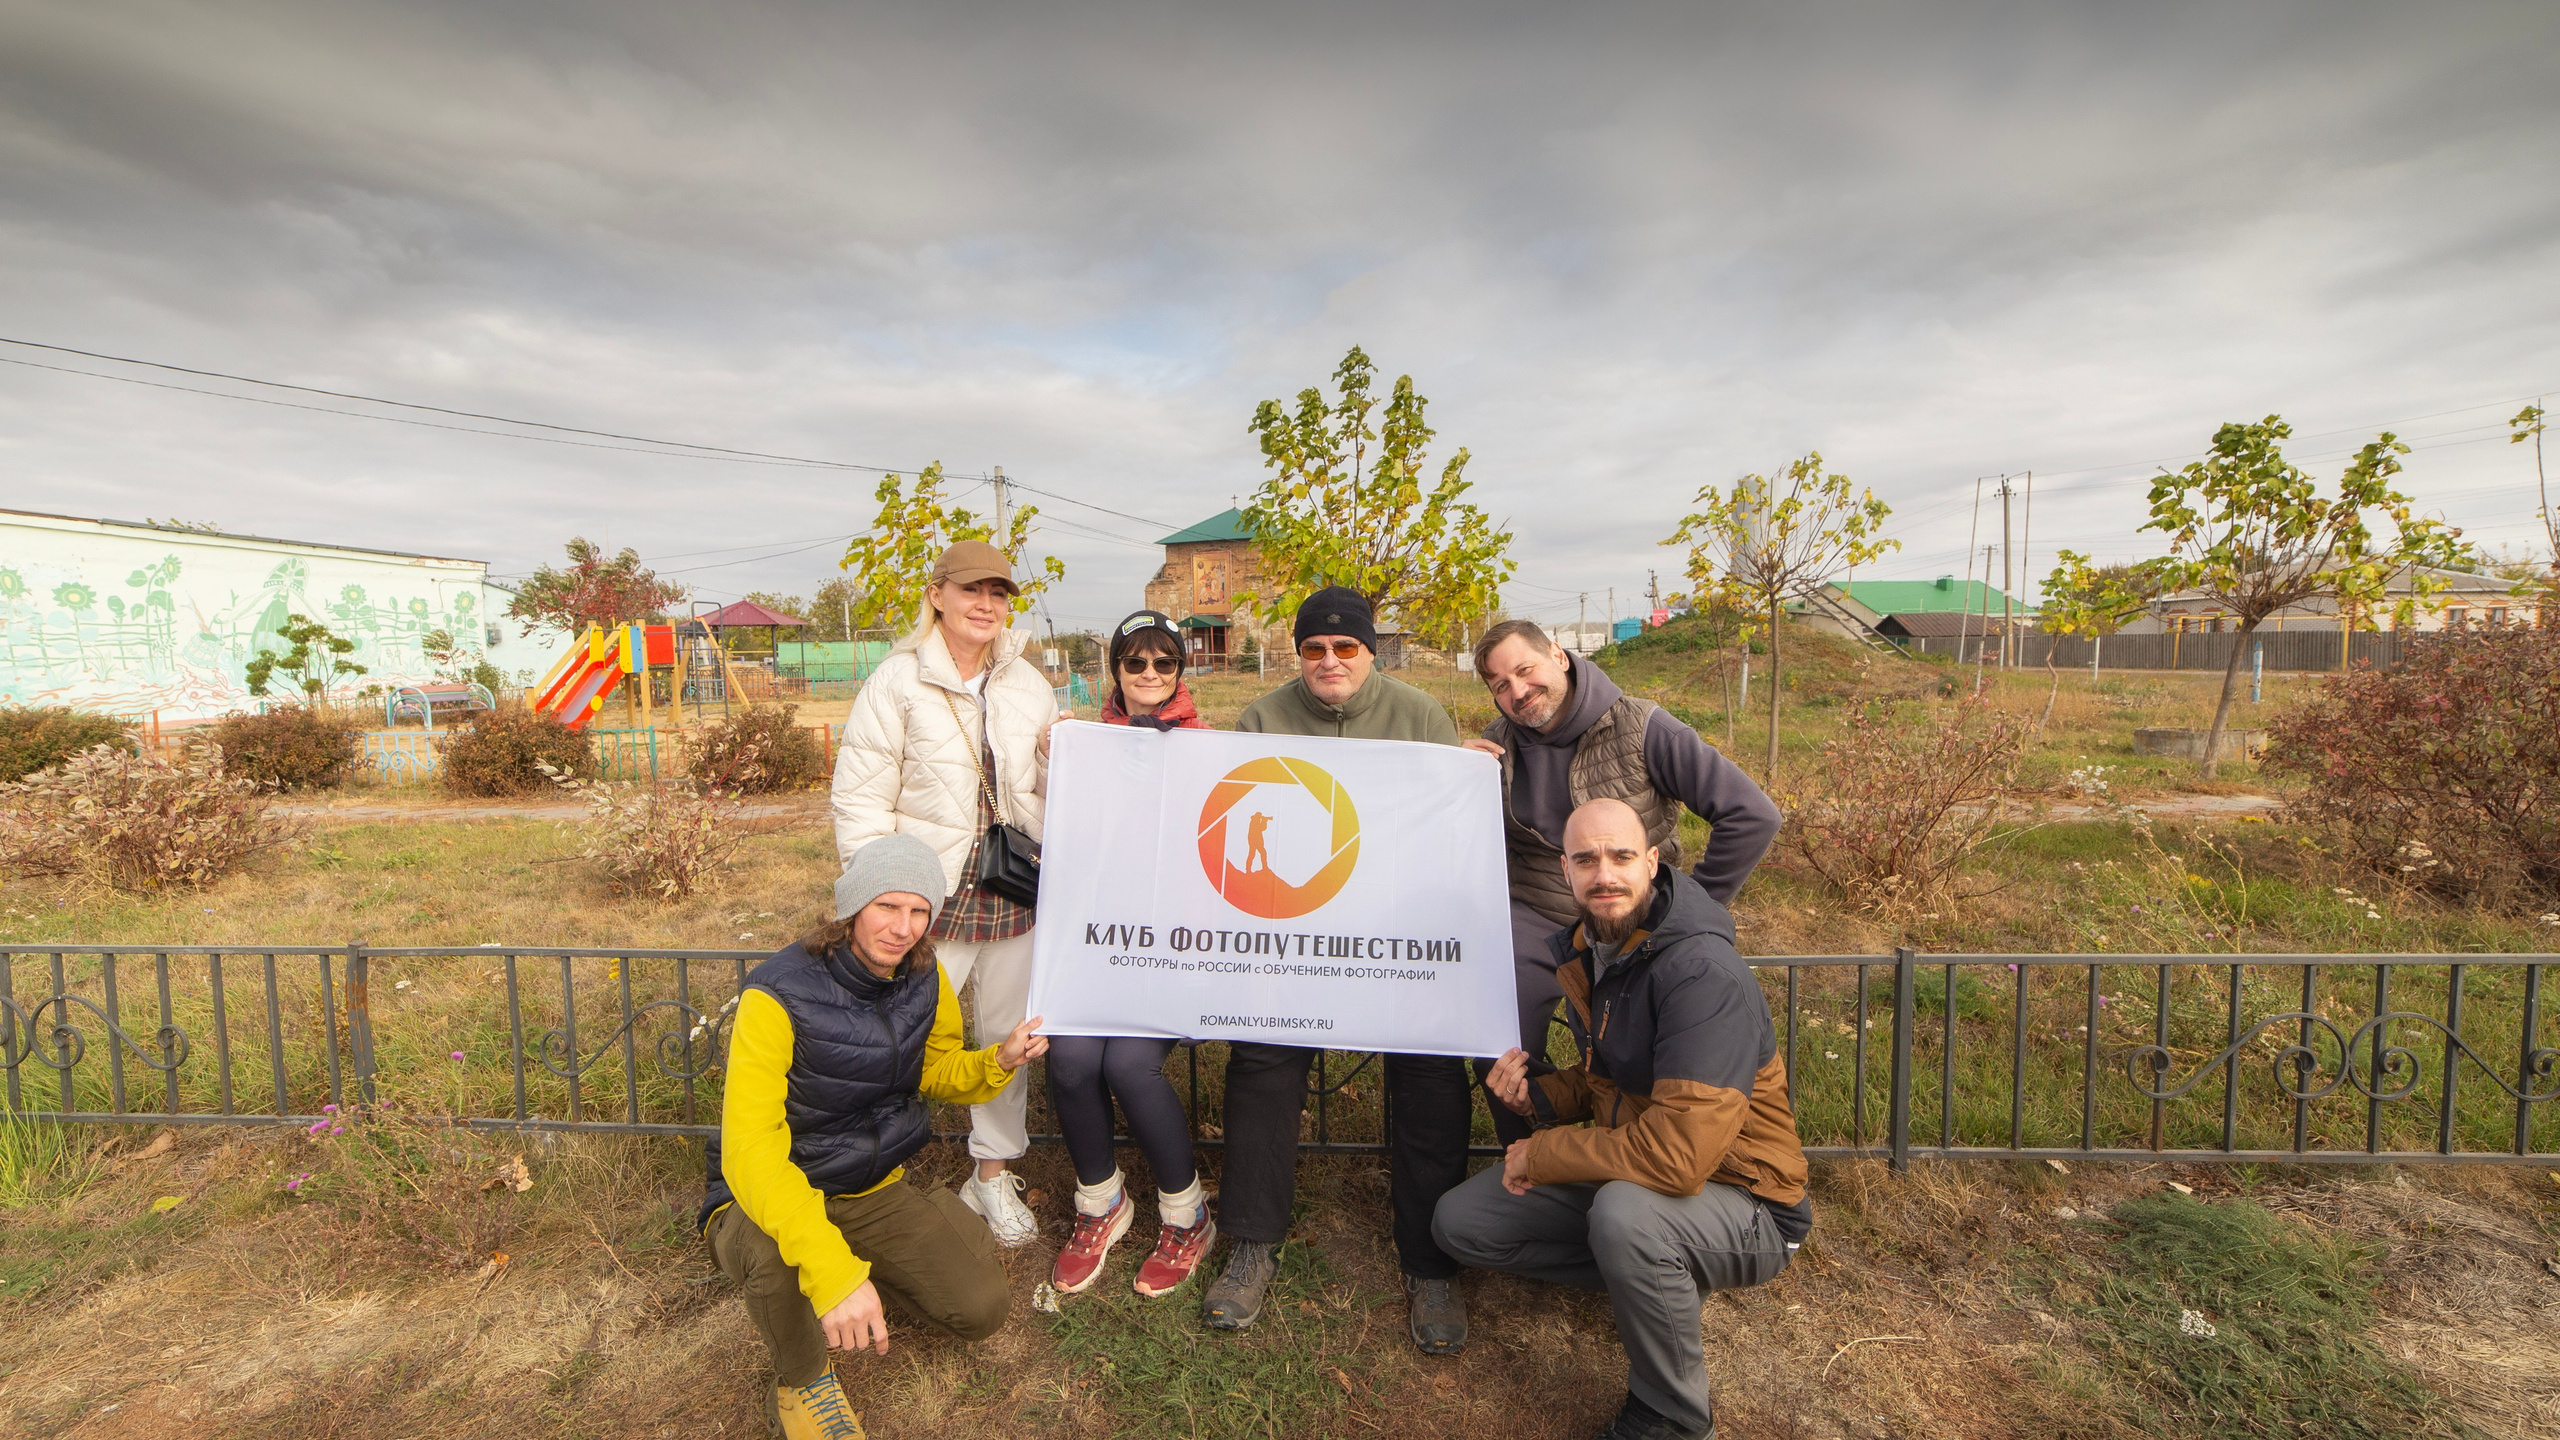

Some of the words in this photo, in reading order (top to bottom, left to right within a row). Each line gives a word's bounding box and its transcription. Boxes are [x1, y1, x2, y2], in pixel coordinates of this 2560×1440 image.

[1085, 922, 1155, 951] КЛУБ
[1169, 926, 1462, 963] ФОТОПУТЕШЕСТВИЙ
[1109, 954, 1179, 970] ФОТОТУРЫ
[1181, 962, 1195, 971] по
[1198, 961, 1251, 974] РОССИИ
[1254, 966, 1261, 974] с
[1263, 963, 1341, 978] ОБУЧЕНИЕМ
[1344, 966, 1436, 981] ФОТОГРАФИИ
[1200, 1014, 1334, 1030] ROMANLYUBIMSKY.RU
